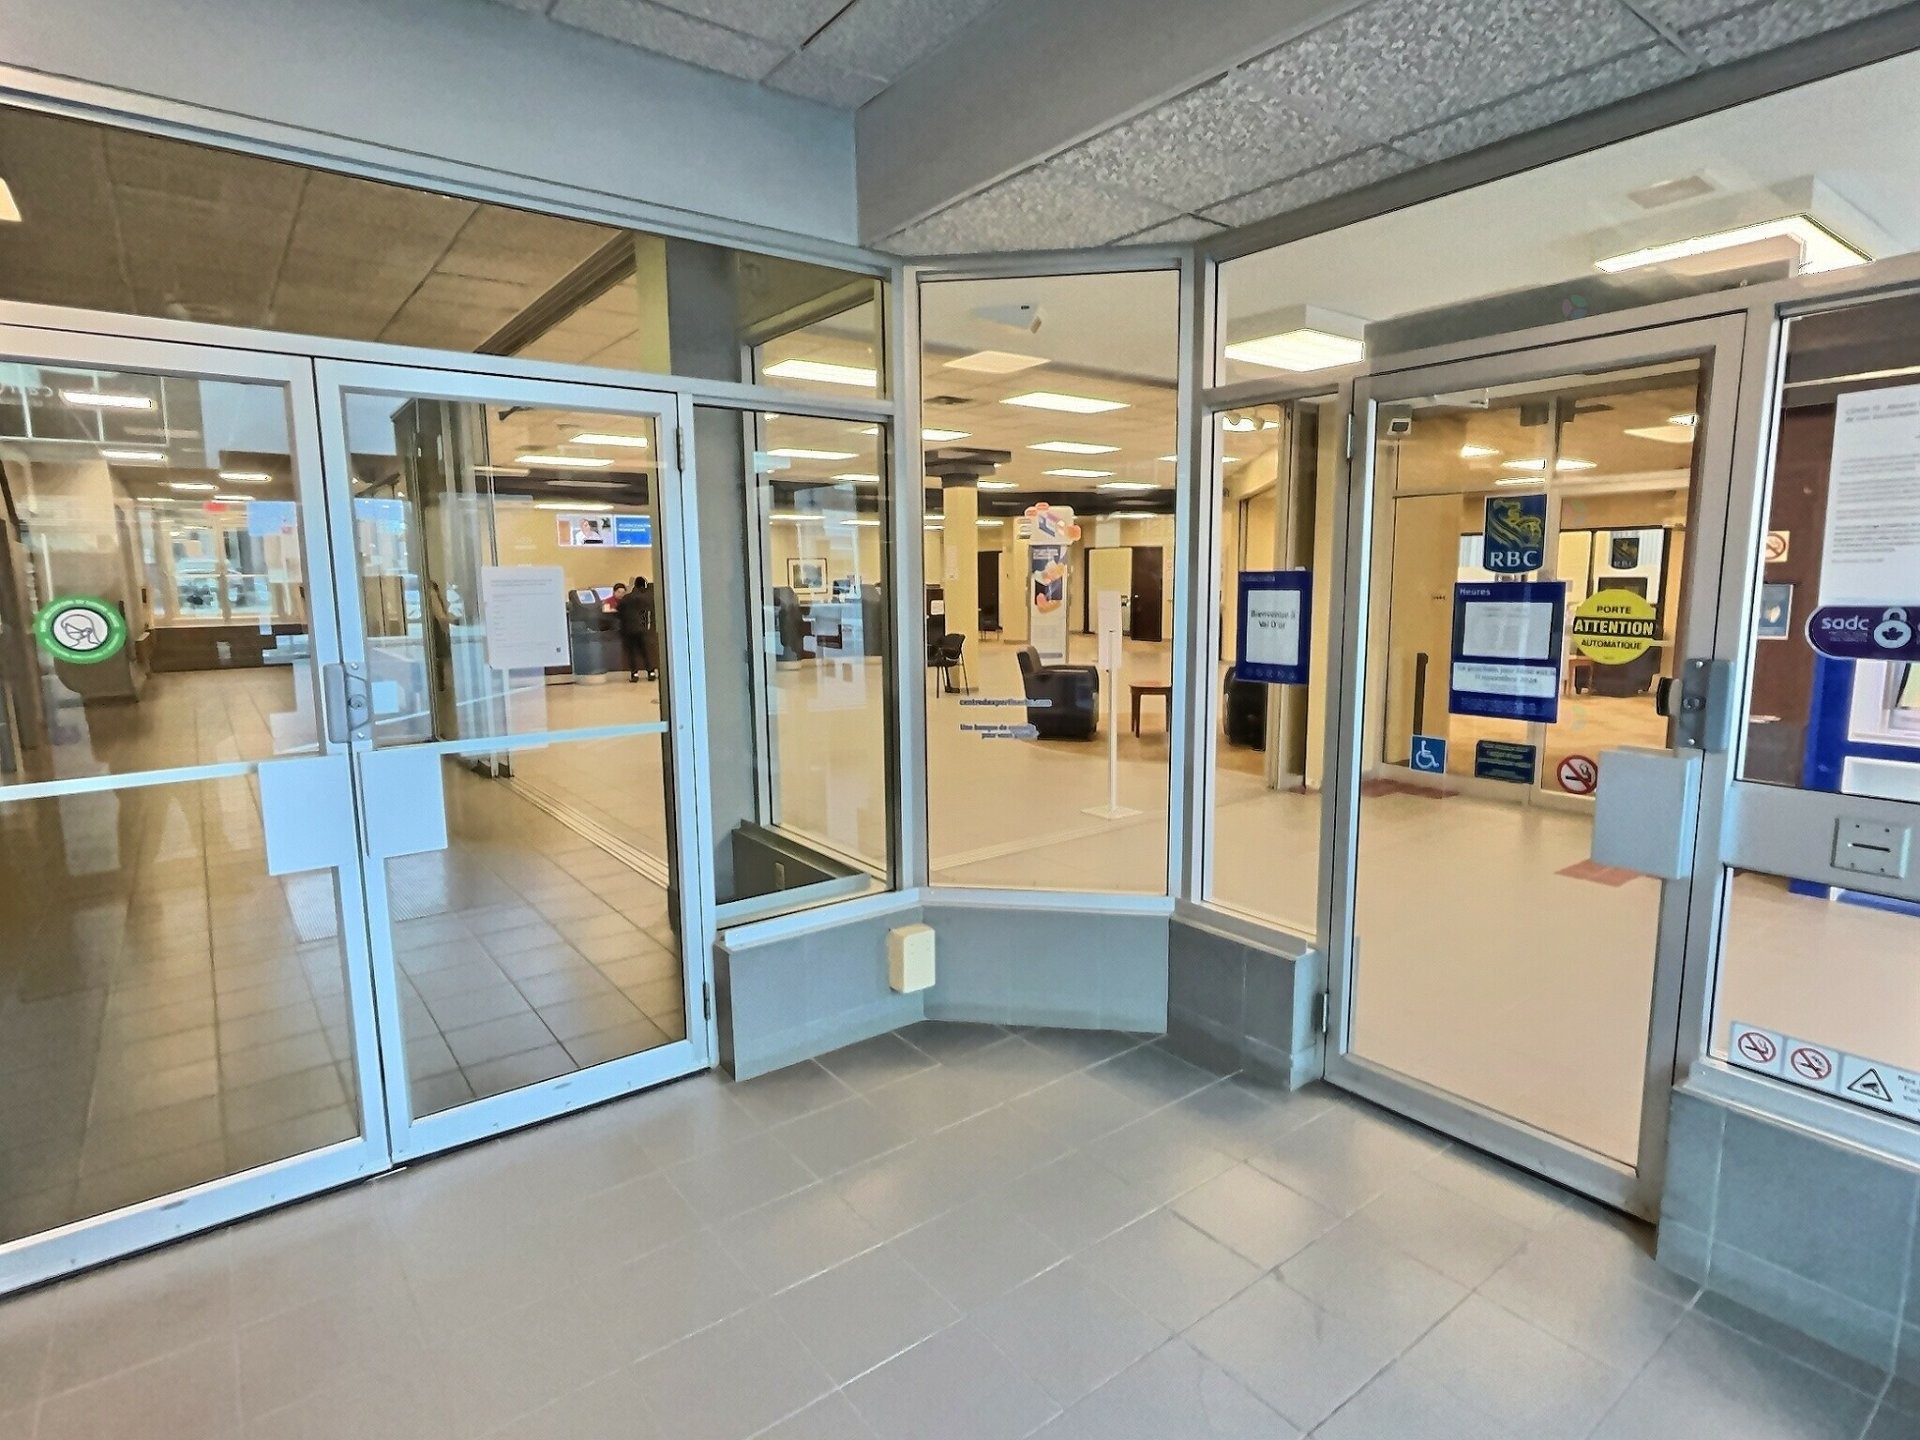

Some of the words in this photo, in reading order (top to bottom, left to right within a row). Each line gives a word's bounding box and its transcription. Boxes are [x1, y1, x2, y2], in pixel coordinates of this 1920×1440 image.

[1489, 550, 1538, 568] RBC
[1460, 588, 1491, 596] Heures
[1596, 605, 1632, 615] PORTE
[1573, 619, 1655, 636] ATTENTION
[1821, 614, 1870, 631] sadc
[1581, 639, 1642, 651] AUTOMATIQUE
